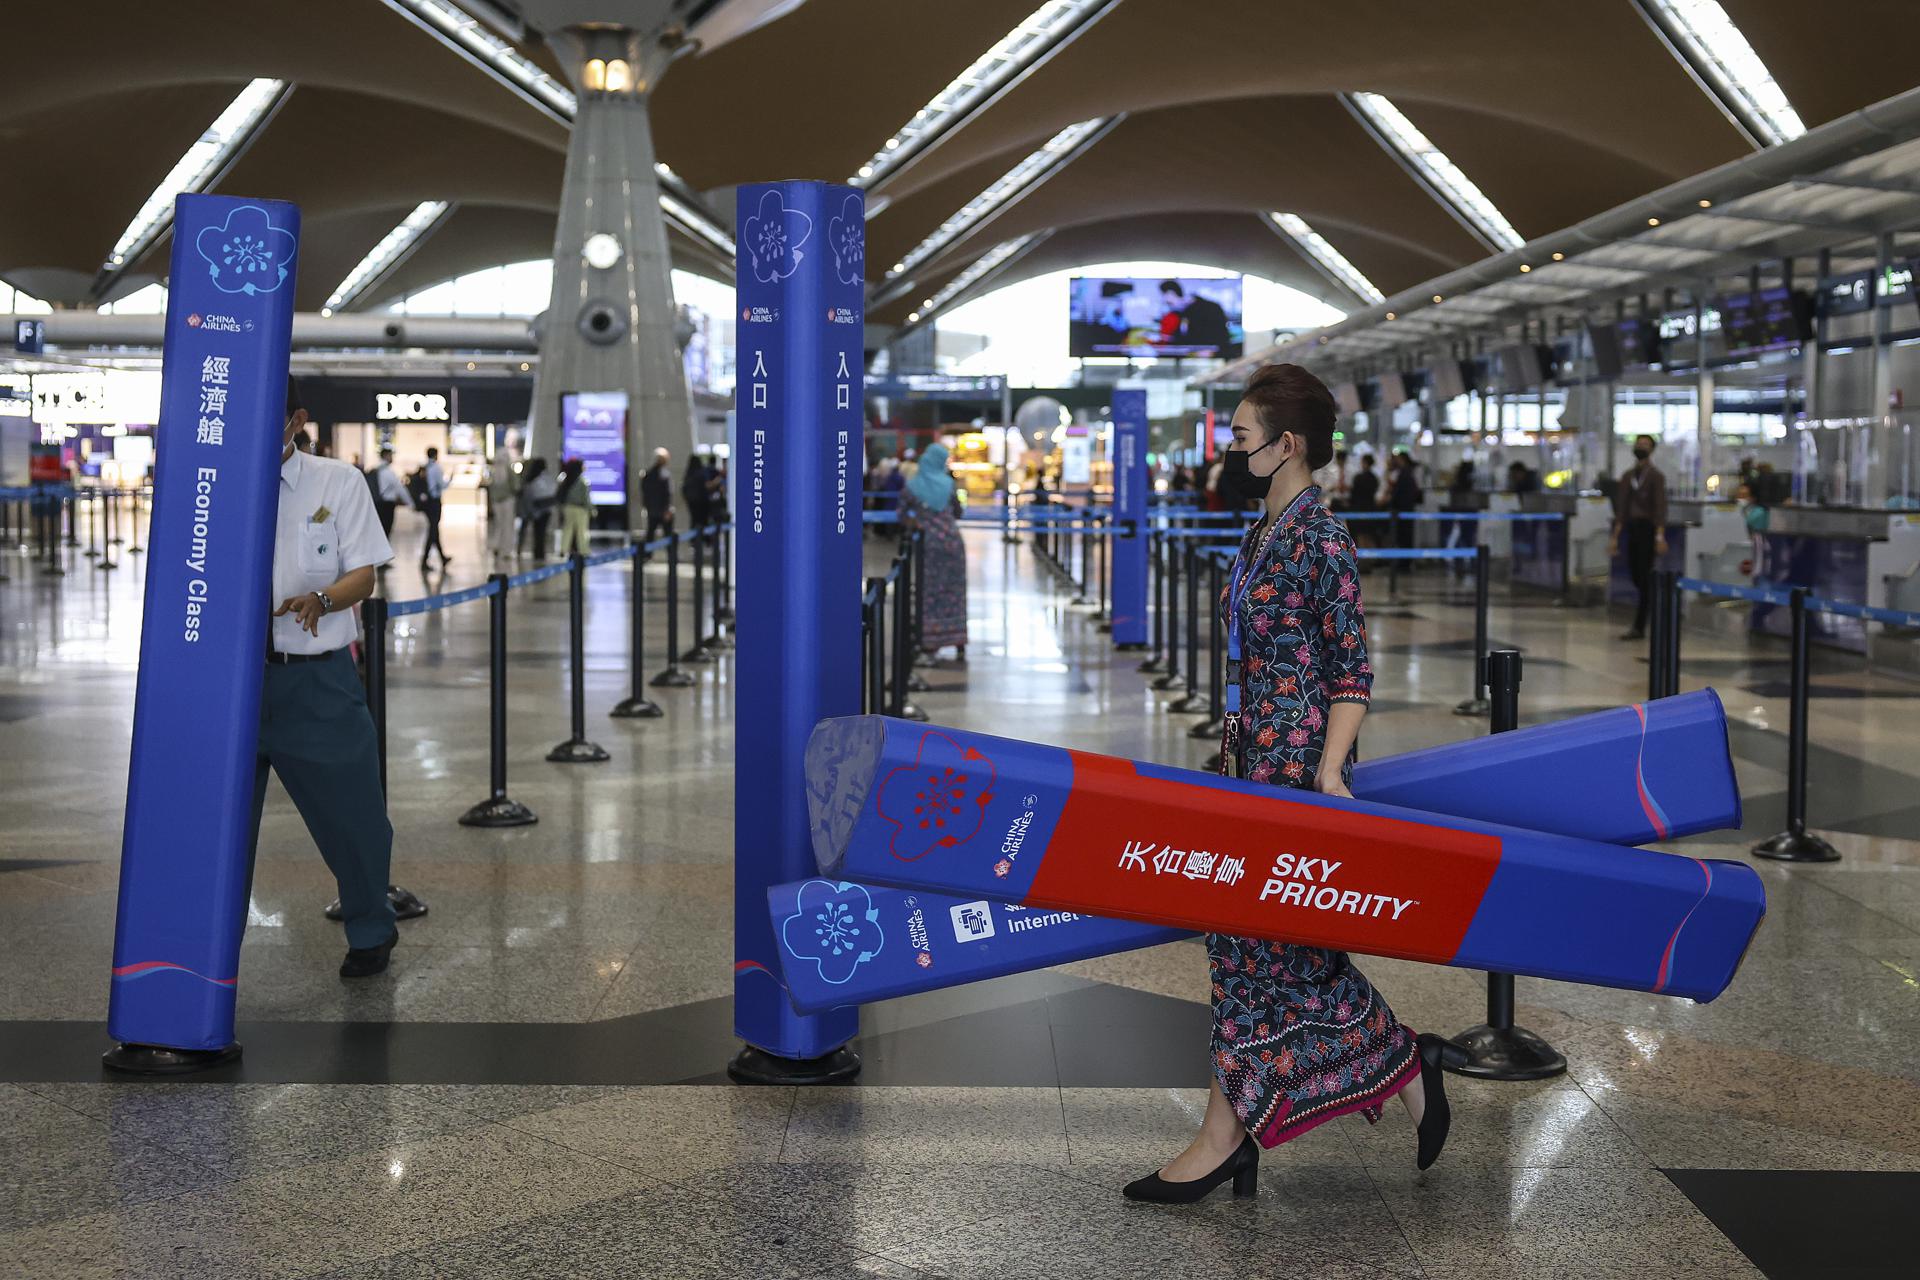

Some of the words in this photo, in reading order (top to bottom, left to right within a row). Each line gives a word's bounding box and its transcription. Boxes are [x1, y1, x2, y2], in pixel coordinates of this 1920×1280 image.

[200, 322, 241, 333] AIRLINES
[206, 314, 236, 324] CHINA
[750, 314, 773, 322] AIRLINES
[752, 307, 770, 315] CHINA
[835, 316, 854, 324] AIRLINES
[836, 308, 851, 316] CHINA
[196, 354, 231, 446] 經濟艙
[752, 350, 768, 409] 入口
[836, 351, 850, 410] 入口
[376, 393, 450, 420] DIOR
[754, 430, 765, 533] Entrance
[838, 430, 848, 534] Entrance
[185, 467, 217, 574] Economy
[184, 578, 208, 643] Class
[1001, 816, 1023, 853] CHINA
[1007, 810, 1034, 861] AIRLINES
[1117, 840, 1246, 887] 天合優享
[1271, 853, 1342, 884] SKY
[1259, 878, 1413, 920] PRIORITY
[907, 916, 920, 949] CHINA
[913, 908, 931, 952] AIRLINES
